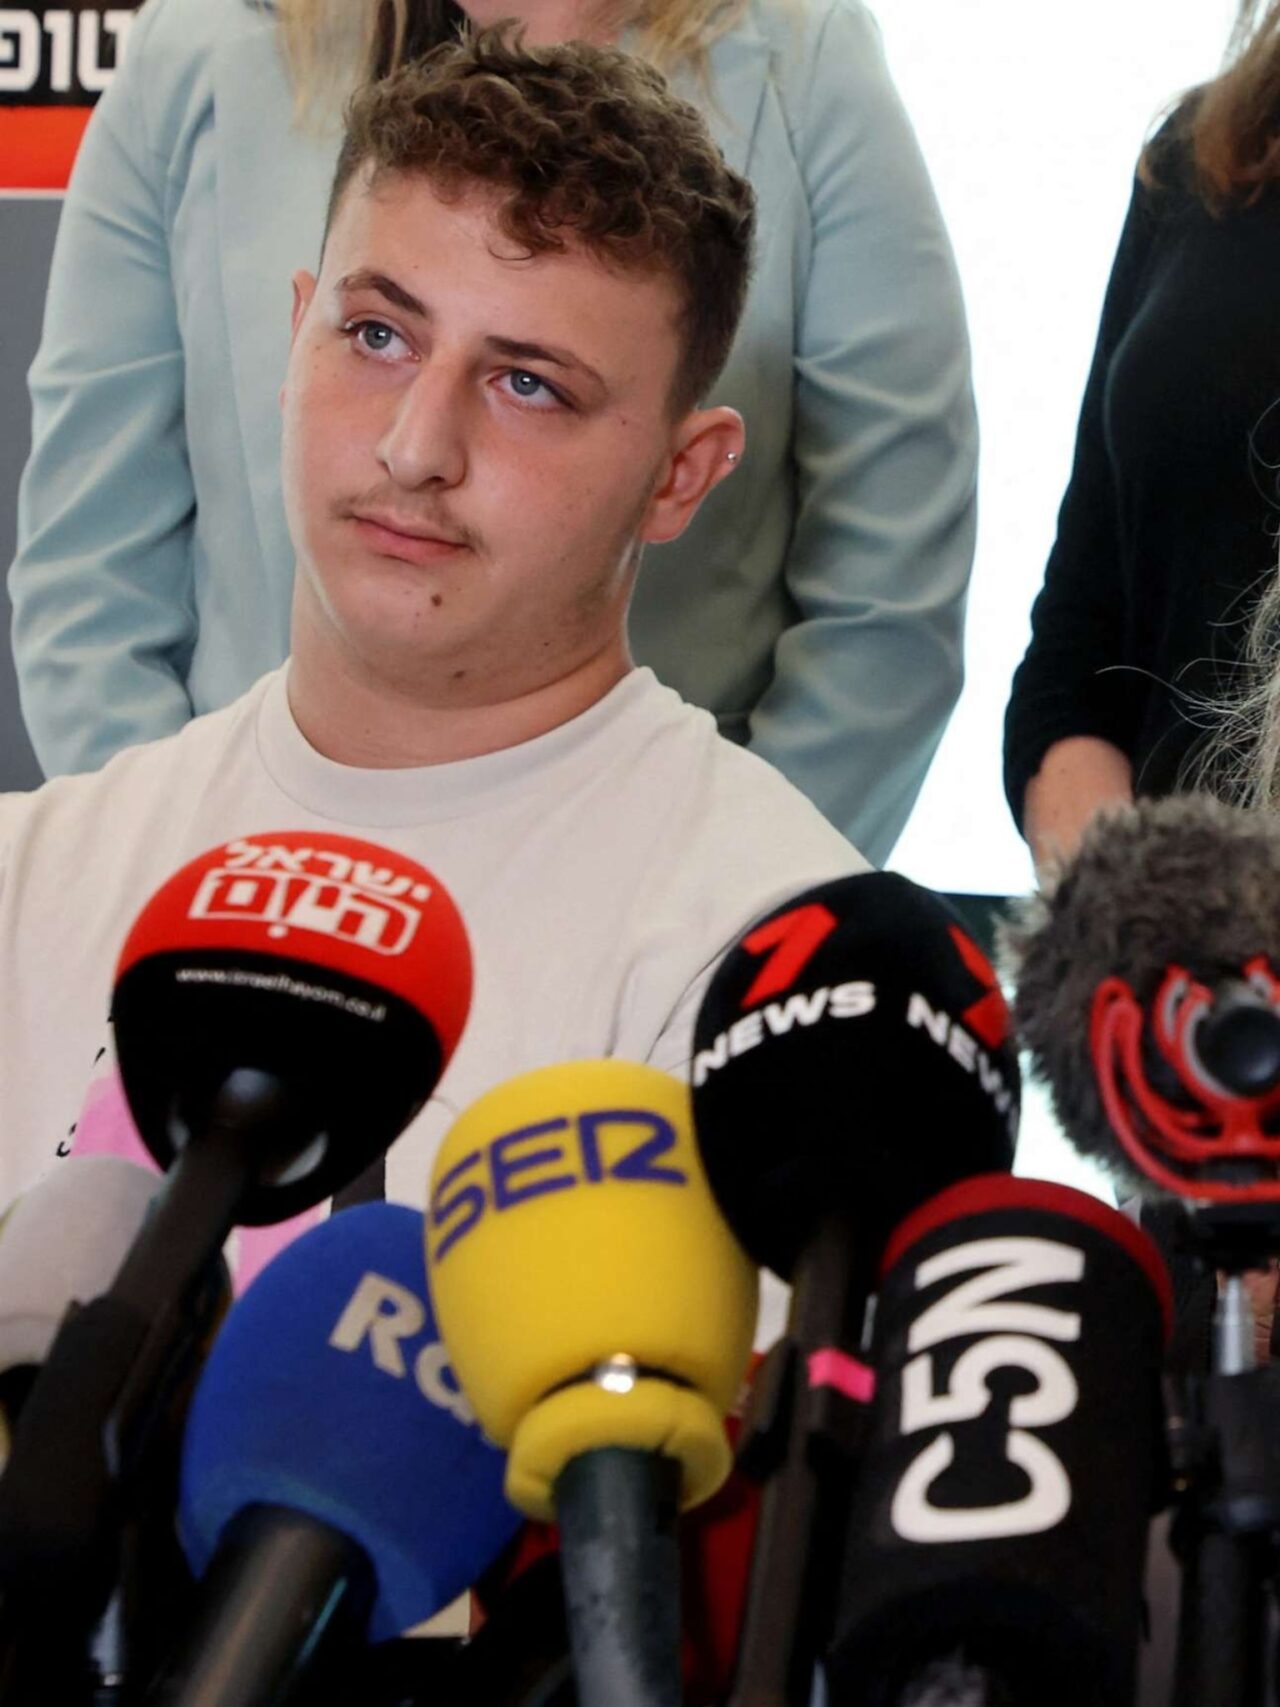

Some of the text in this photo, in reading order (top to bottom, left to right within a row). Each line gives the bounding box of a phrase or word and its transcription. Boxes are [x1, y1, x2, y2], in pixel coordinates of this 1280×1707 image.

[224, 839, 432, 902] ישראל
[740, 902, 838, 1008] 7
[692, 980, 876, 1087] NEWS
[430, 1109, 688, 1266] SER
[891, 1236, 1085, 1544] C5N
